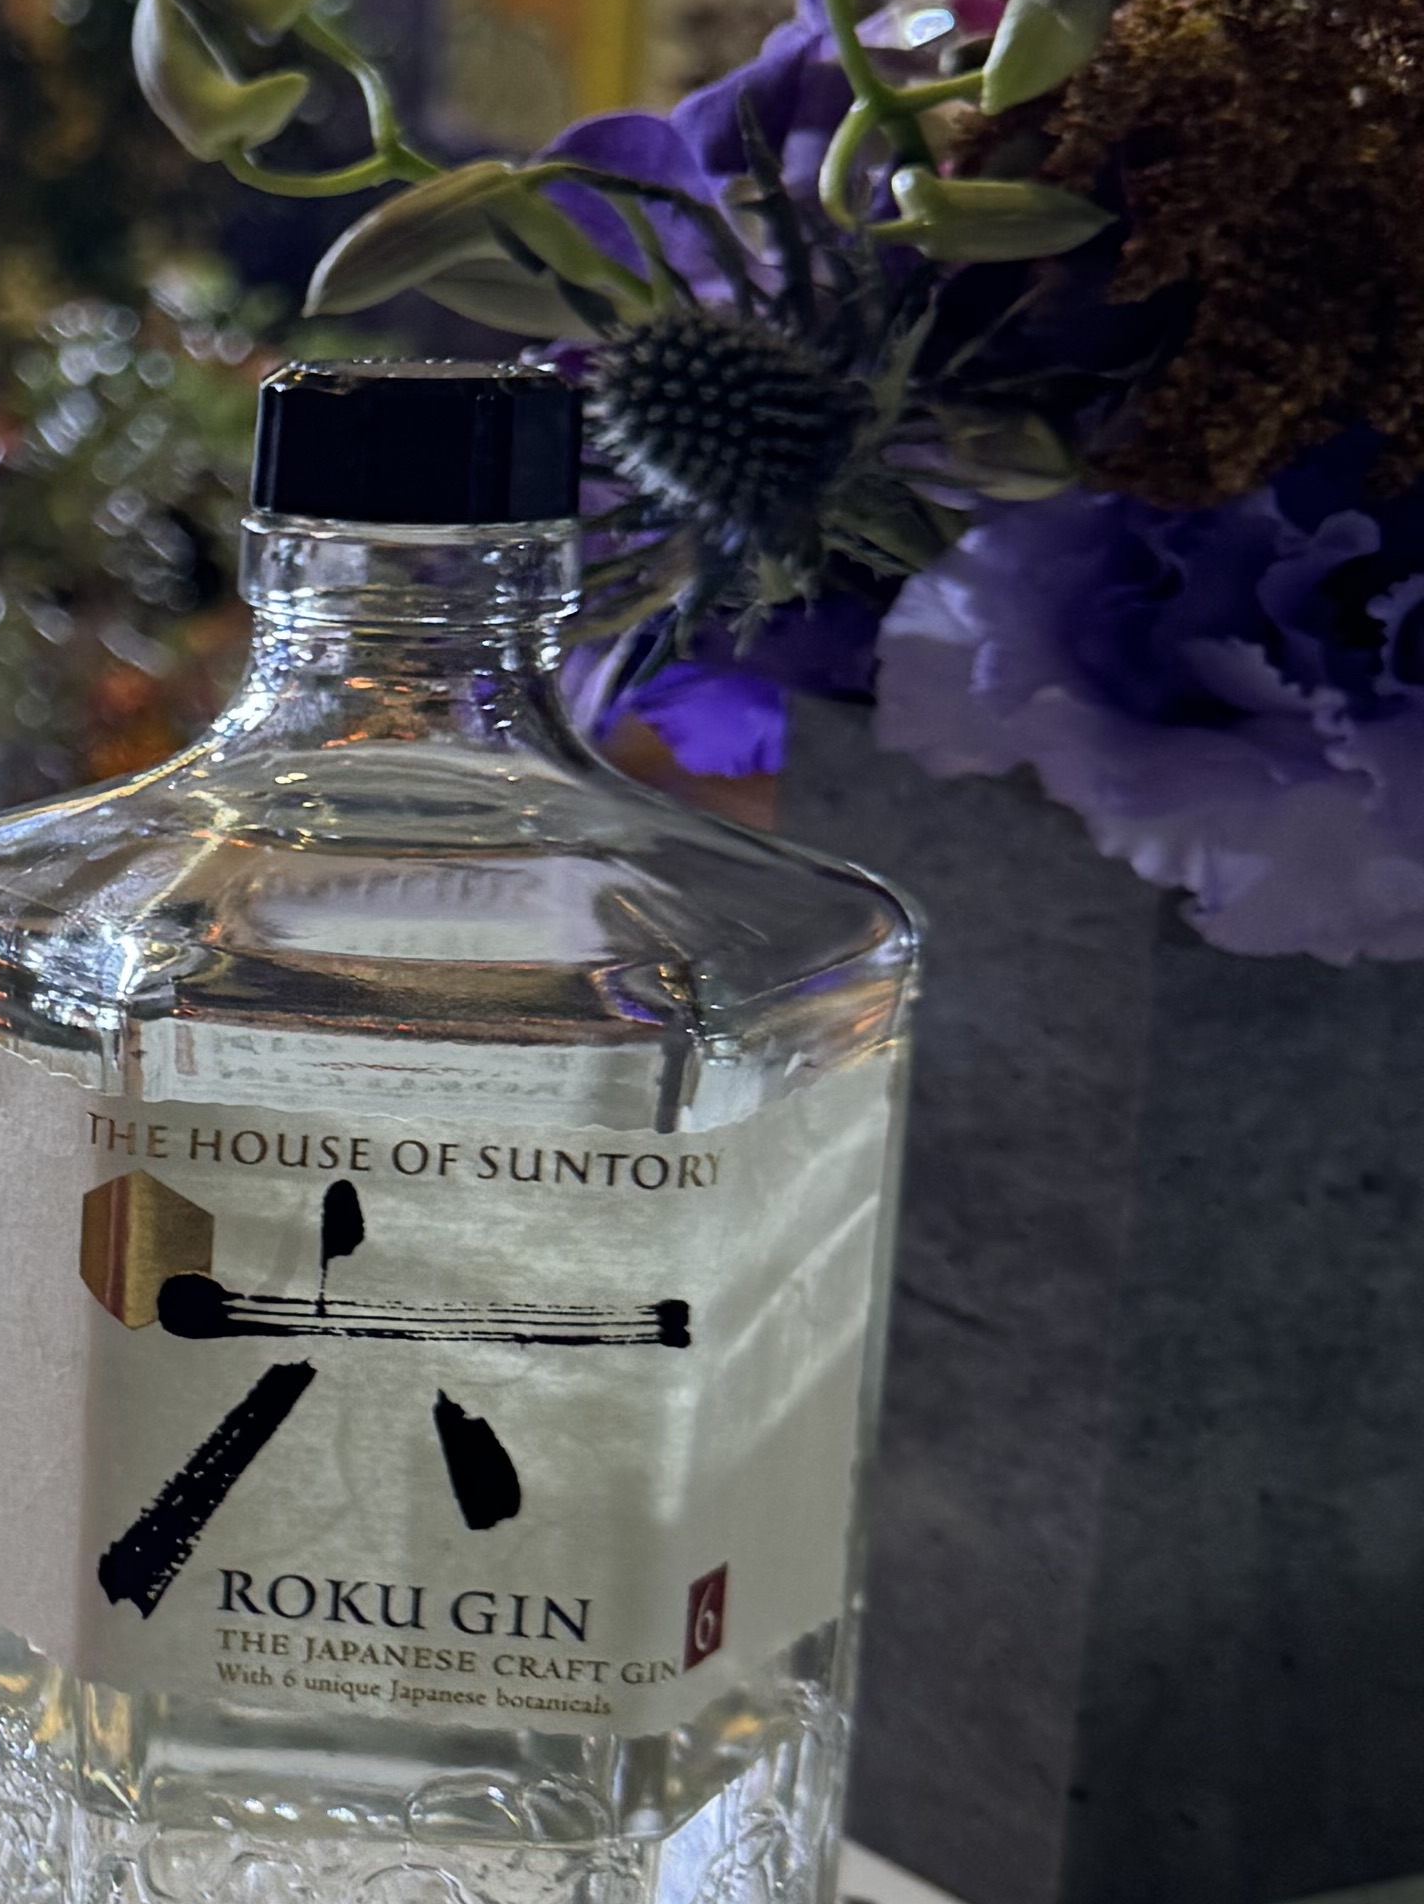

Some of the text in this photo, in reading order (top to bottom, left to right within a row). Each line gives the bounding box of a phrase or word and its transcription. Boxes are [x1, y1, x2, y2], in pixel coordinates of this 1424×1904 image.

[87, 1111, 725, 1191] THE HOUSE OF SUNTORY
[217, 1568, 593, 1642] ROKU GIN
[217, 1628, 678, 1685] THE JAPANESE CRAFT GIN
[217, 1662, 612, 1715] With 6 unique Japanese botanicals
